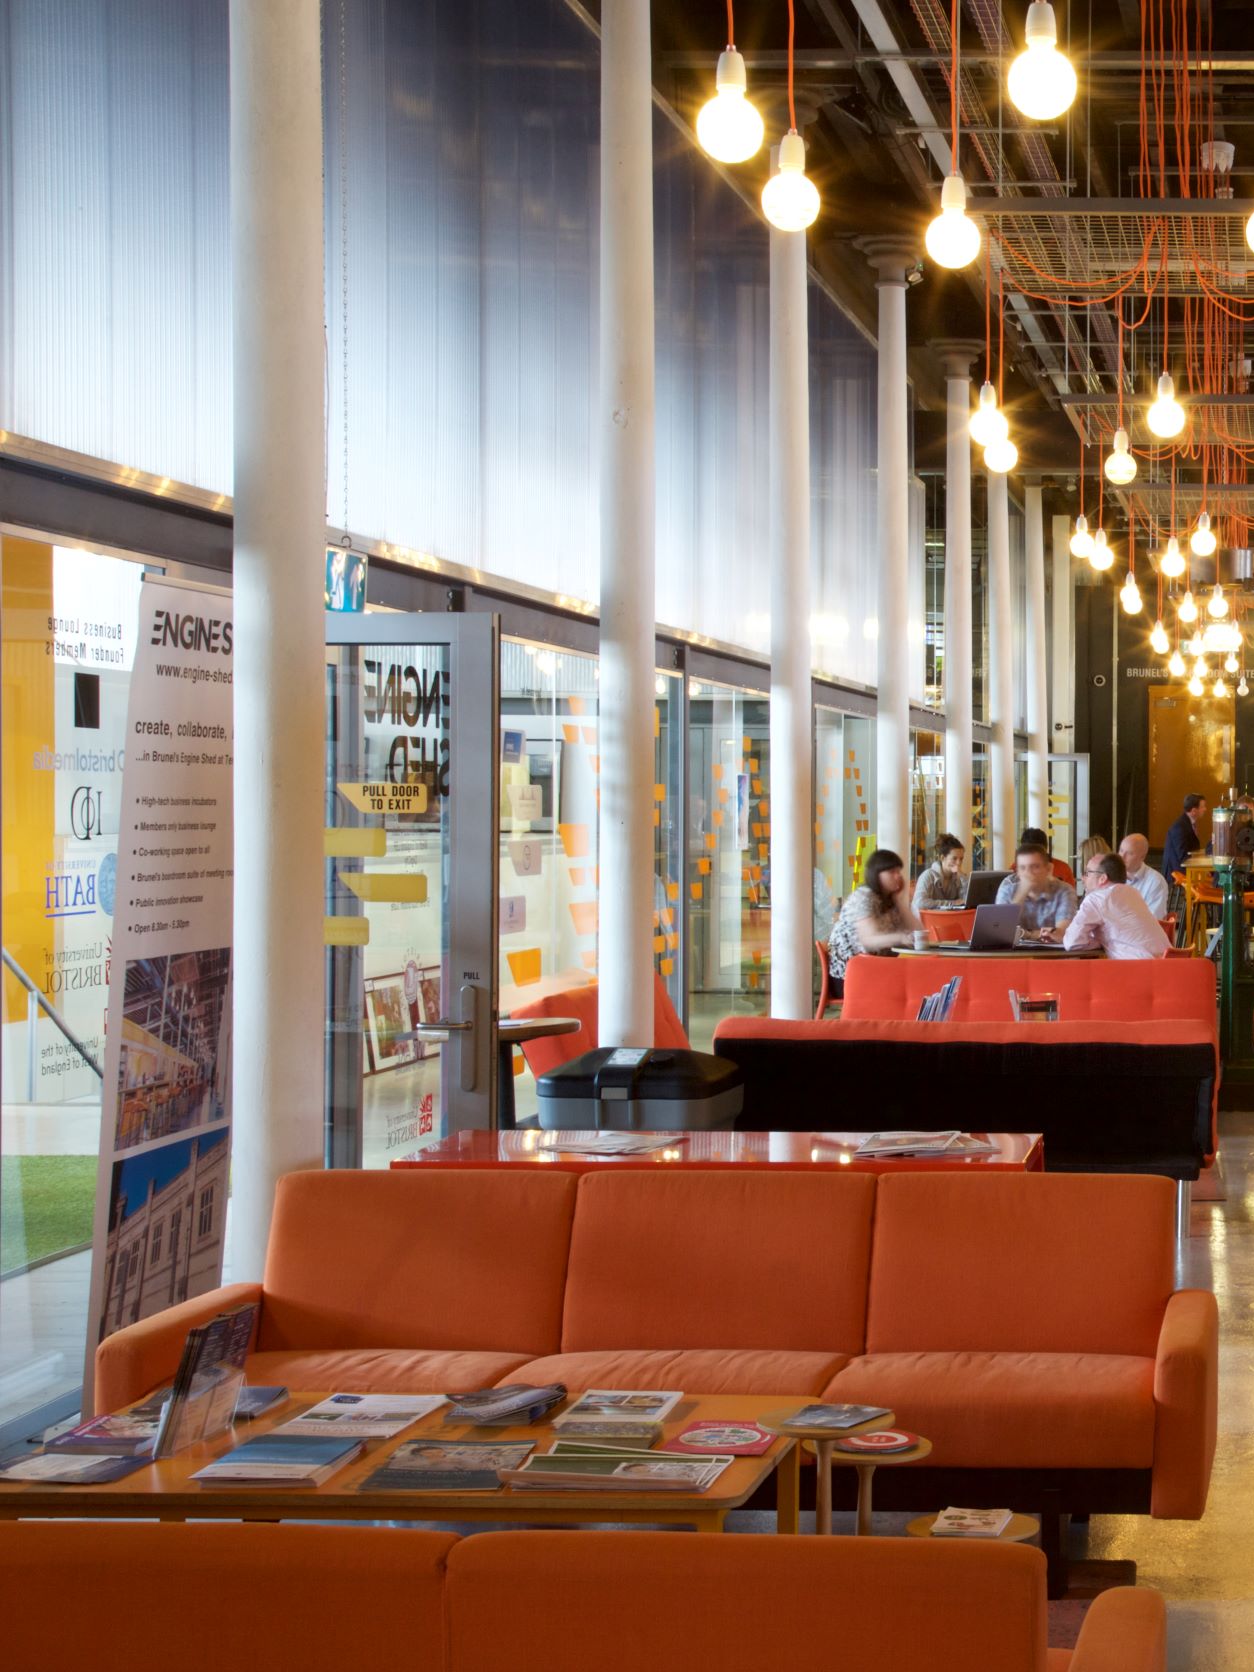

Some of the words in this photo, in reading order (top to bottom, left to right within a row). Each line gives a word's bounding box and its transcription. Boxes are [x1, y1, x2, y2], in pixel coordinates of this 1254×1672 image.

[1126, 668, 1169, 678] BRUNEL'S
[135, 720, 172, 738] create,
[177, 721, 227, 741] collaborate,
[152, 750, 180, 763] Brunel's
[180, 752, 200, 766] Engine
[201, 753, 217, 764] Shed
[362, 785, 387, 797] PULL
[391, 785, 420, 797] DOOR
[370, 798, 383, 810] TO
[388, 798, 412, 810] EXIT
[463, 971, 480, 980] PULL
